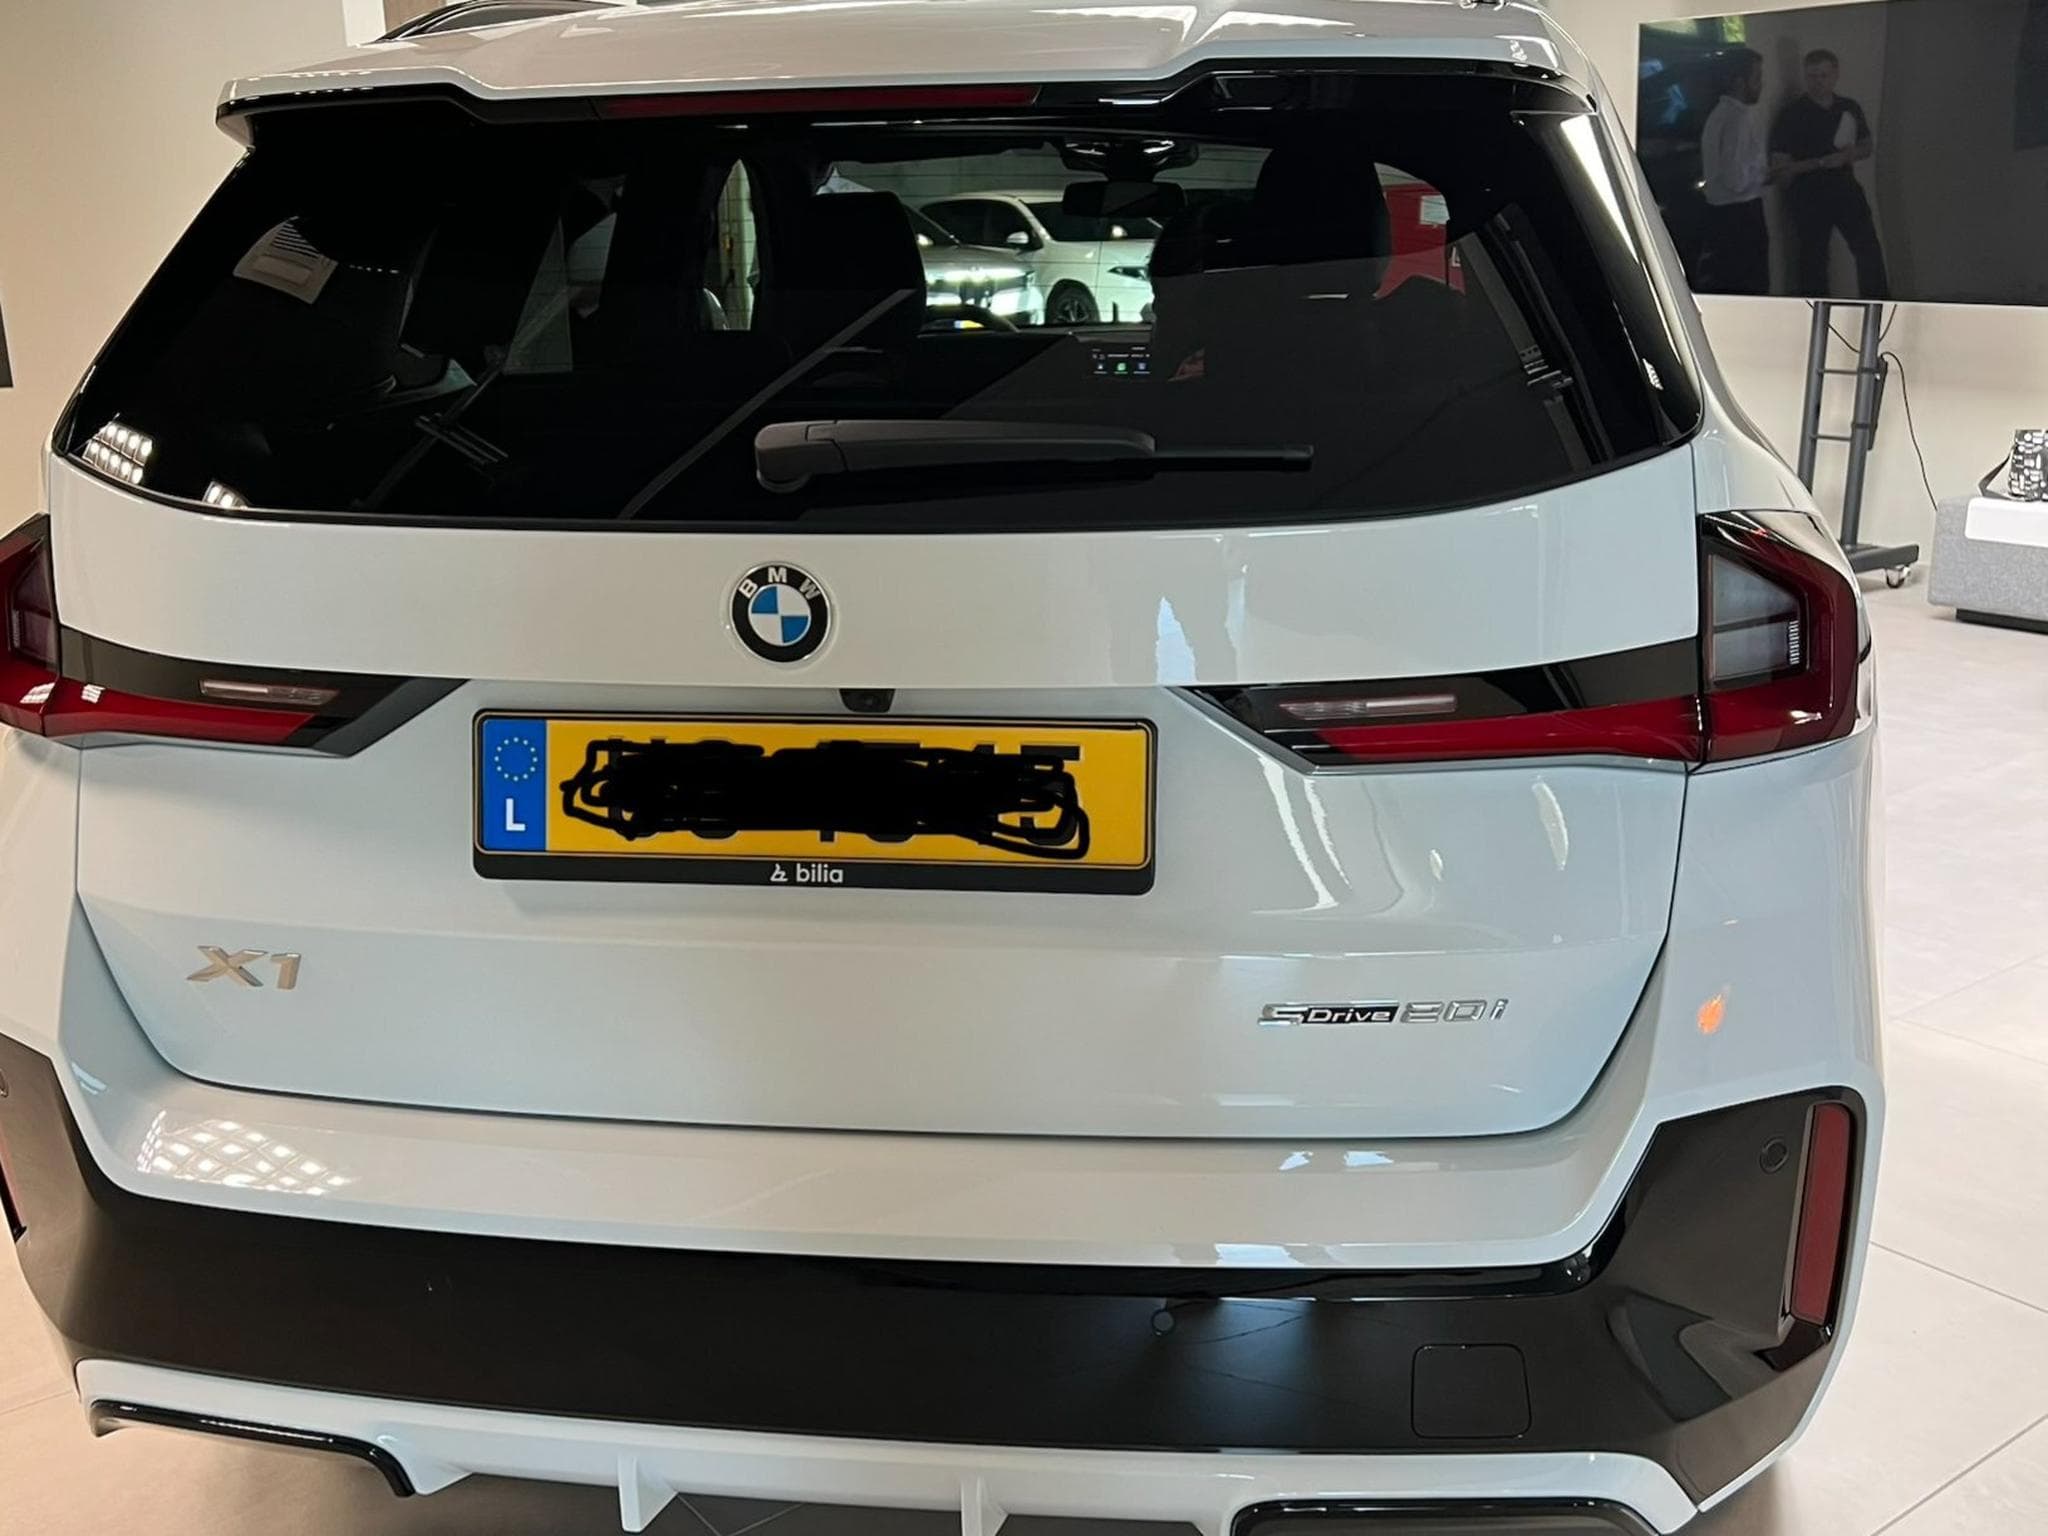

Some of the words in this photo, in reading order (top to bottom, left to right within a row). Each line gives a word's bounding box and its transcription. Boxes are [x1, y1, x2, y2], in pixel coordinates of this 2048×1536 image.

[738, 566, 821, 600] BMW
[505, 797, 526, 832] L
[796, 863, 844, 883] bilia
[186, 945, 302, 990] X1
